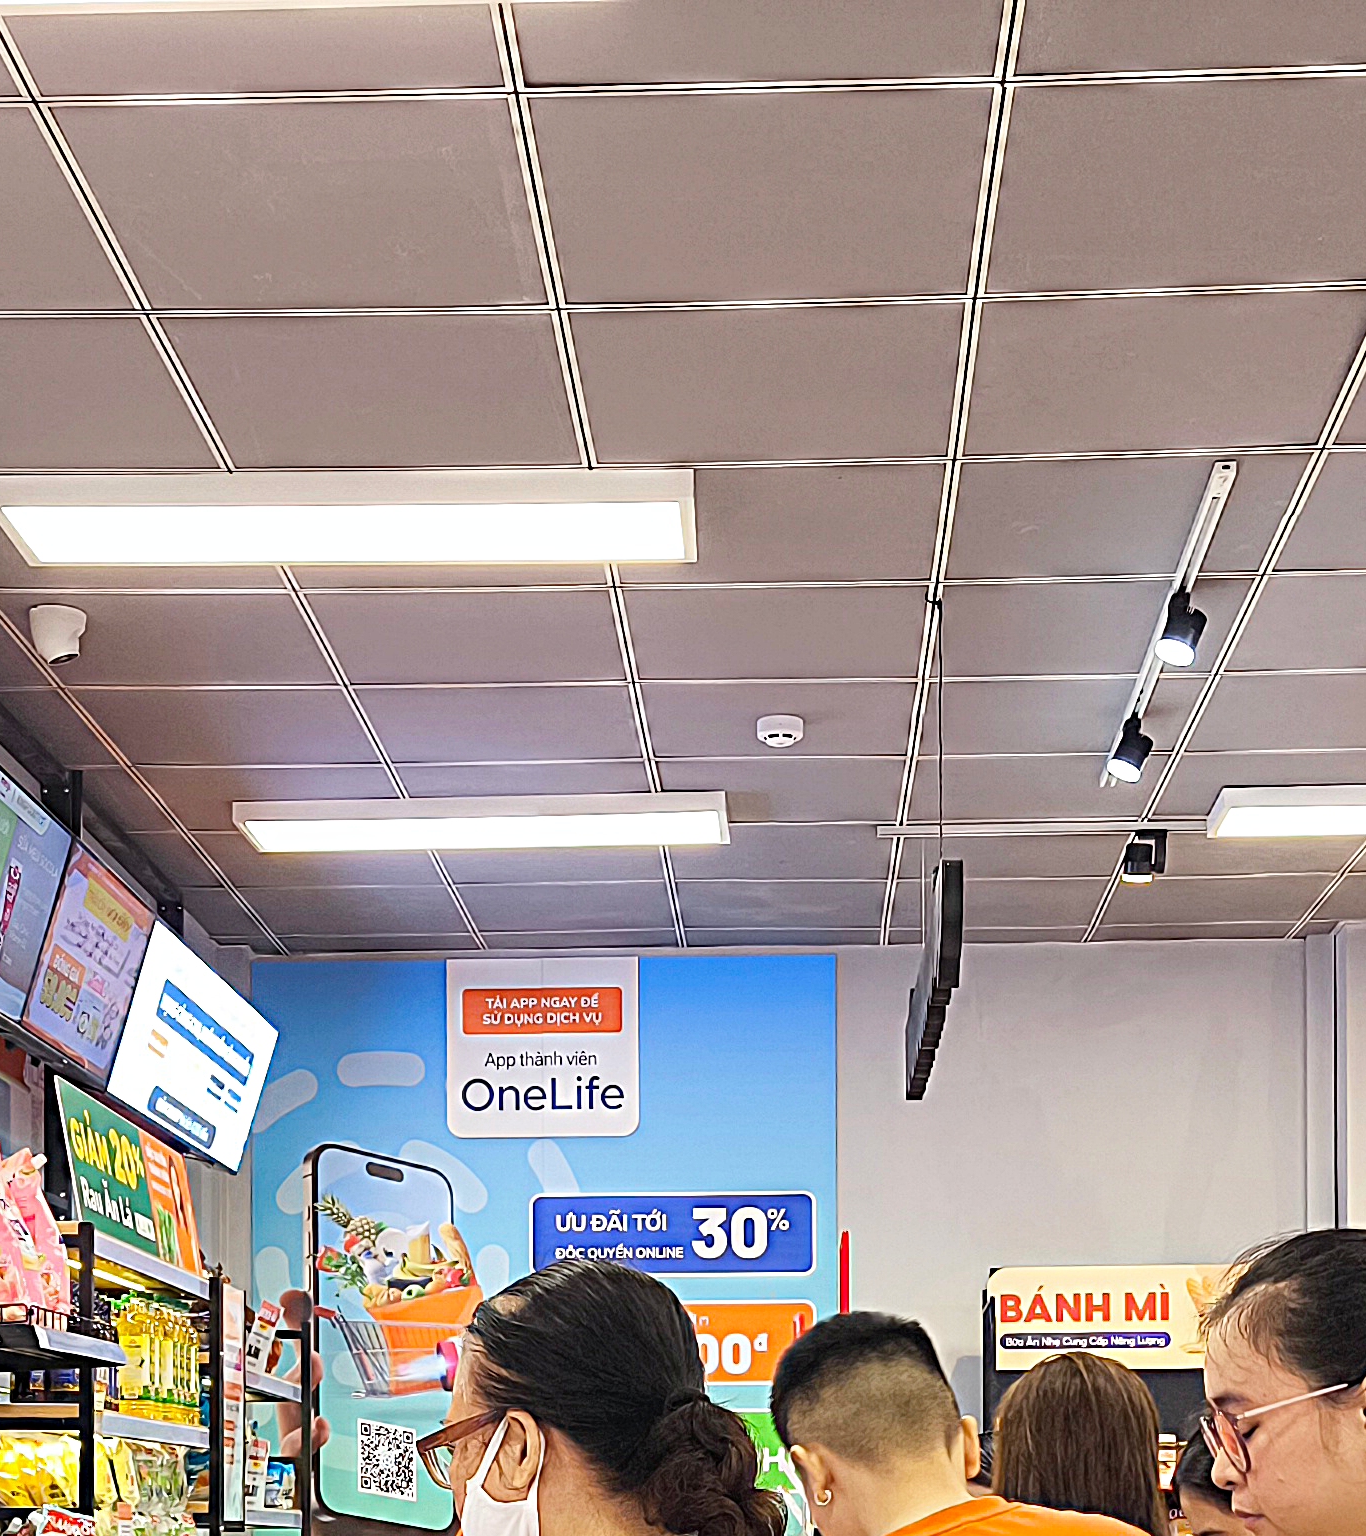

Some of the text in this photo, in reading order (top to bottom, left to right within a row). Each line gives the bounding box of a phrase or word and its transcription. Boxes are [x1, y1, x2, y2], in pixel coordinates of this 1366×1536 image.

[510, 998, 537, 1009] APP
[541, 997, 577, 1008] NGAY
[505, 1013, 543, 1027] DỤNG
[547, 1012, 579, 1026] DỊCH
[583, 1012, 602, 1026] VỤ
[485, 1051, 597, 1070] App thành viên
[462, 1076, 625, 1112] OneLife
[69, 1109, 113, 1176] GIẢM
[590, 1209, 628, 1233] ĐÃI
[632, 1209, 667, 1232] TỚI
[635, 1246, 684, 1259] ONLINE
[1000, 1283, 1170, 1323] BÁNH MÌ
[1062, 1337, 1088, 1348] Cung
